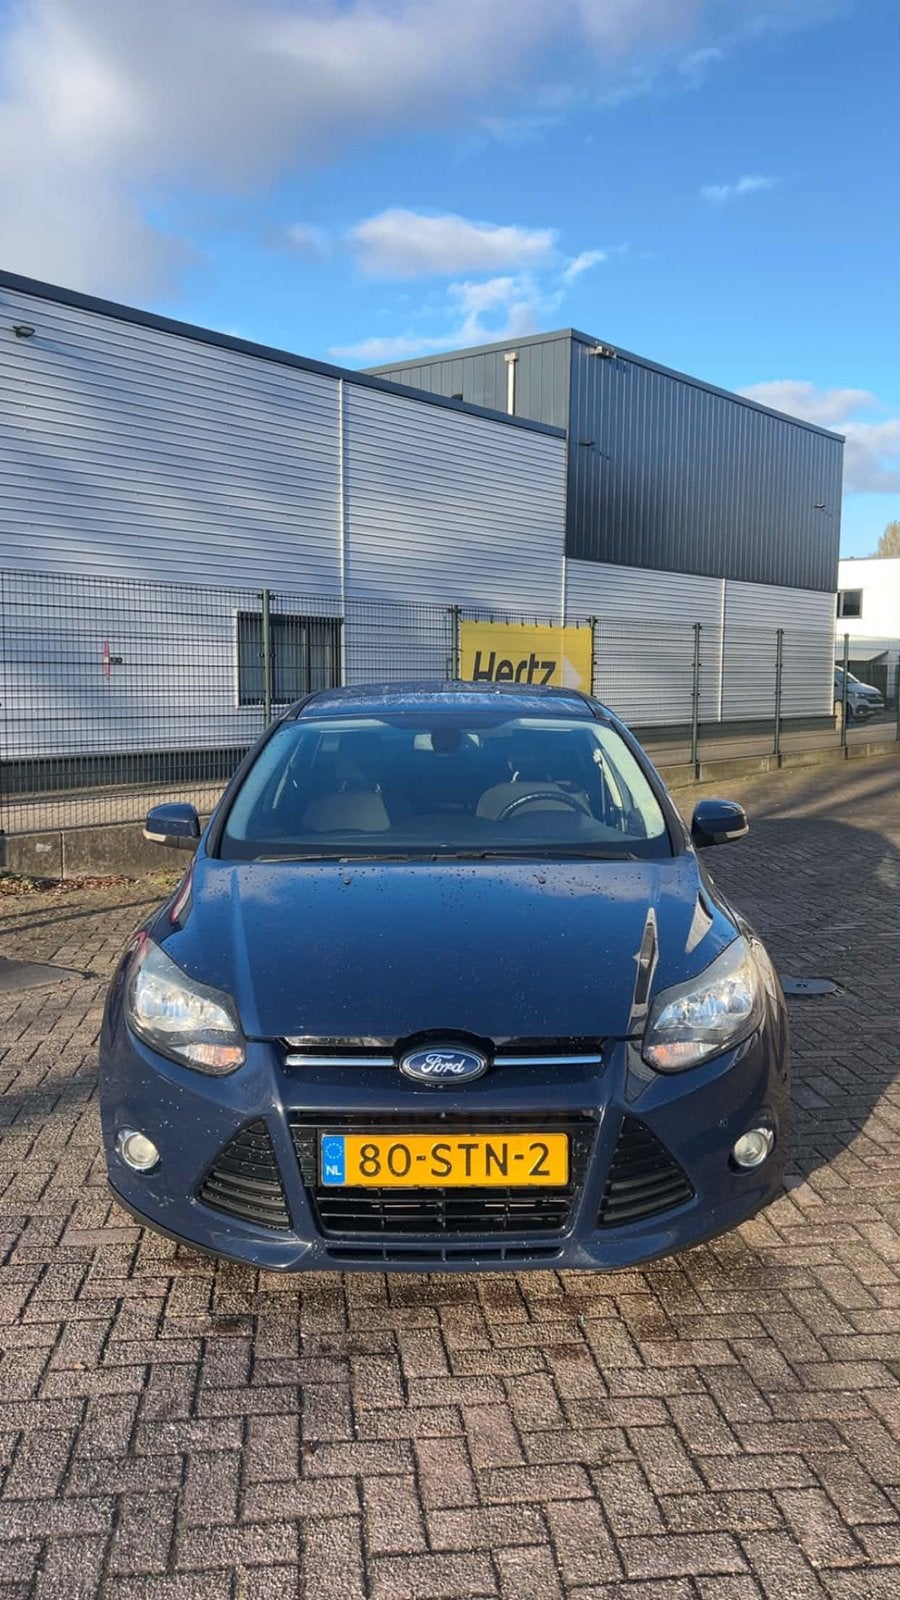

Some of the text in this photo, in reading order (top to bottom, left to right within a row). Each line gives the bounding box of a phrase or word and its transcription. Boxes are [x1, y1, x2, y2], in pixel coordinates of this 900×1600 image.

[473, 651, 556, 685] Hertz
[421, 1053, 466, 1073] Ford
[326, 1164, 343, 1177] NL
[358, 1142, 551, 1178] 80-STN-2
